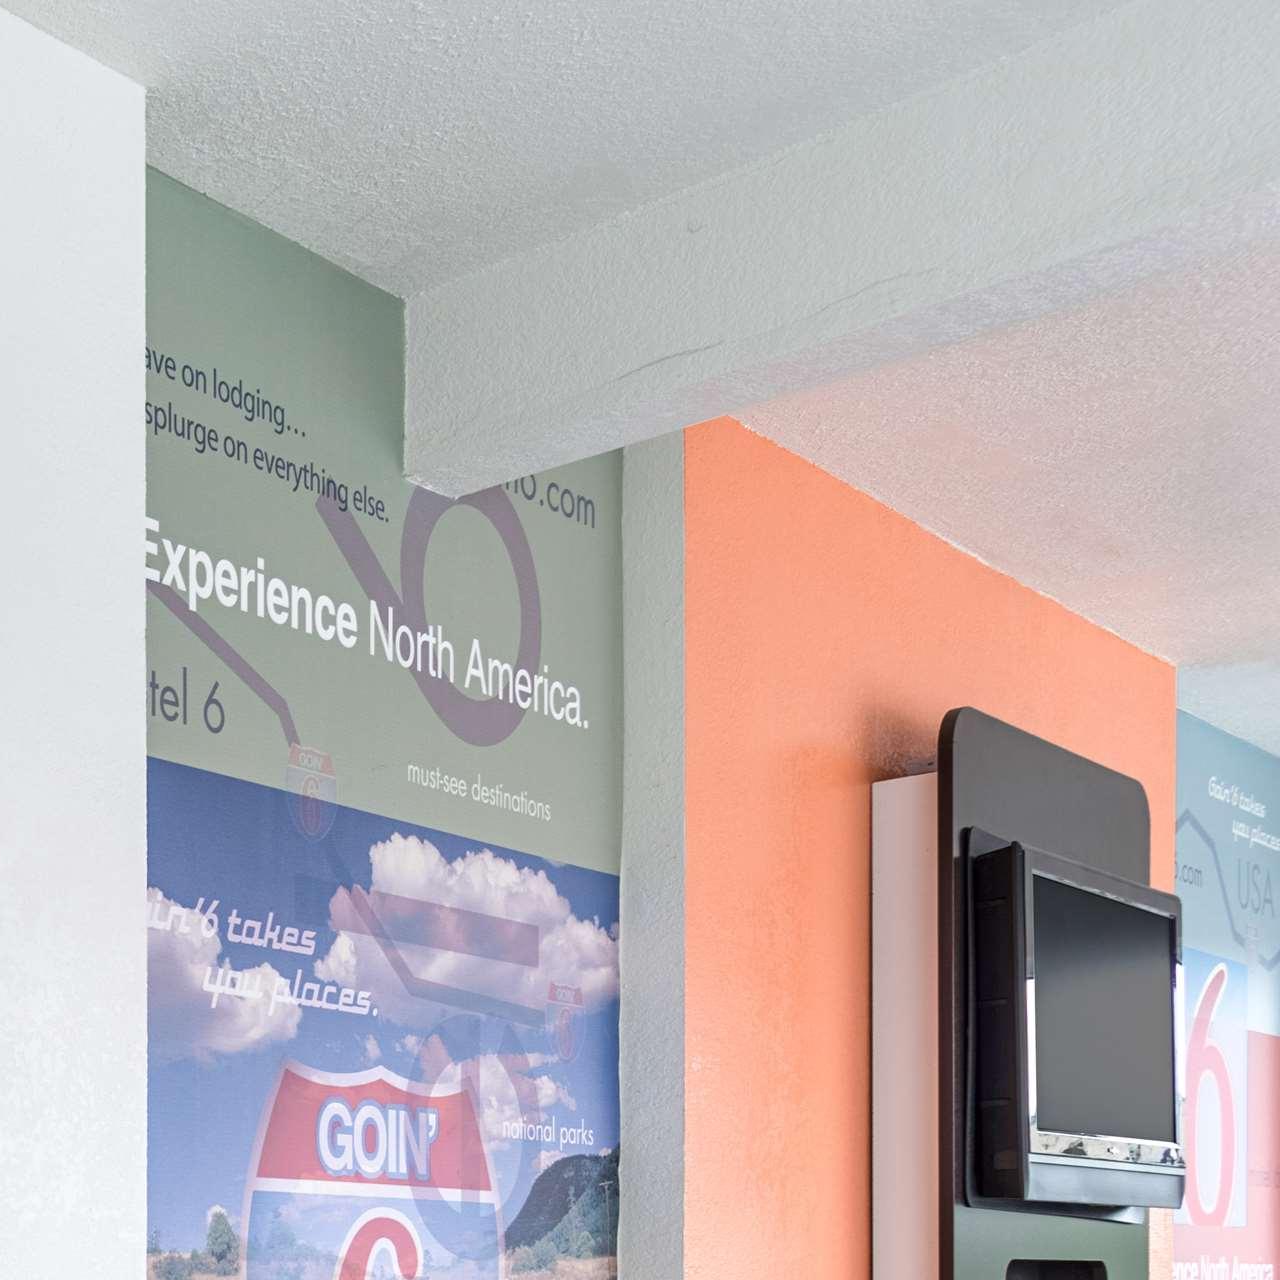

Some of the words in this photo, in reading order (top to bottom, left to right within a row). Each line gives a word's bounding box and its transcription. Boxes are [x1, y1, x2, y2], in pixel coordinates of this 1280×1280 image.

[182, 365, 207, 393] on
[213, 368, 306, 437] lodging...
[145, 401, 218, 454] splurge
[223, 435, 248, 464] on
[253, 448, 349, 512] everything
[353, 486, 389, 523] else.
[144, 516, 359, 649] Experience
[369, 599, 454, 684] North
[464, 638, 589, 729] America.
[203, 681, 226, 734] 6
[407, 762, 468, 798] must-see
[471, 774, 552, 822] destinations
[1238, 858, 1275, 919] USA
[227, 909, 317, 955] takes
[203, 967, 263, 1008] you
[267, 969, 378, 1017] places.
[1184, 962, 1237, 1228] 6
[318, 1101, 437, 1177] GOIN'
[502, 1115, 556, 1142] national
[559, 1118, 594, 1152] parks
